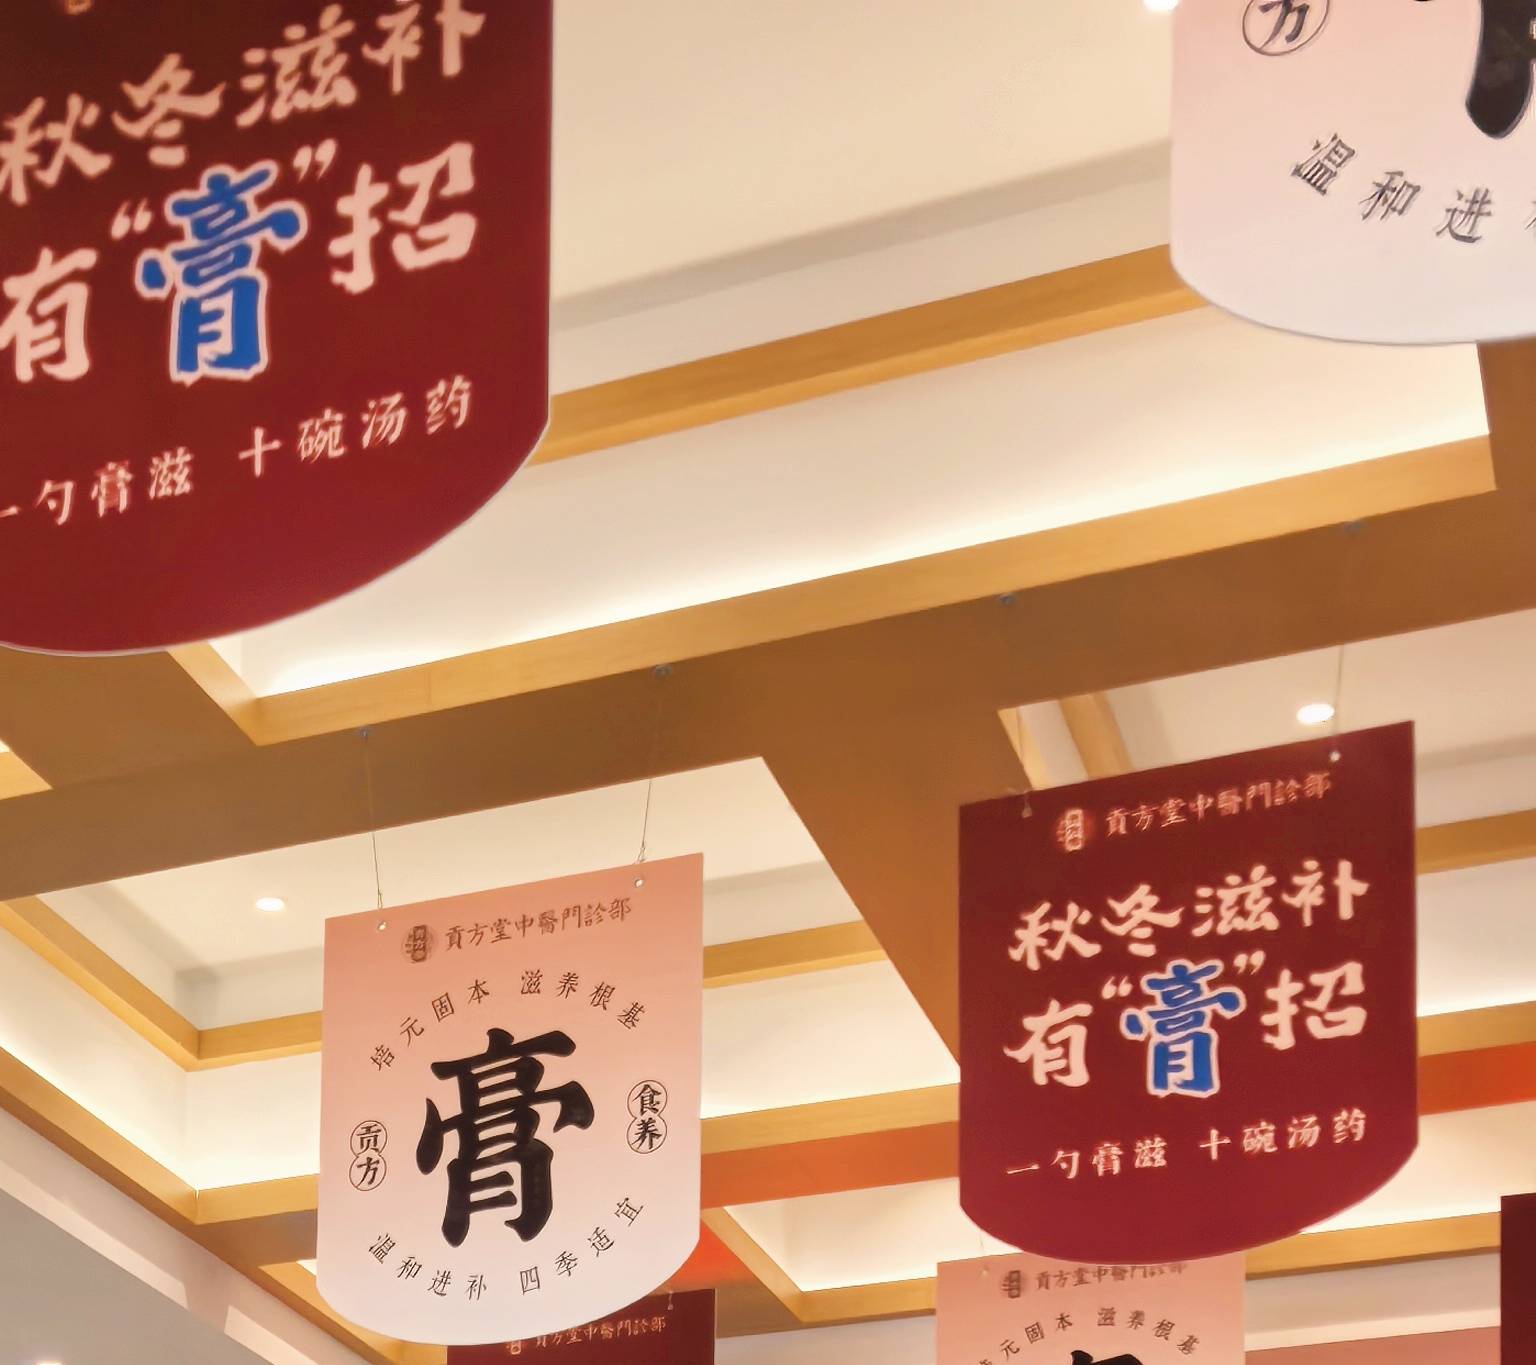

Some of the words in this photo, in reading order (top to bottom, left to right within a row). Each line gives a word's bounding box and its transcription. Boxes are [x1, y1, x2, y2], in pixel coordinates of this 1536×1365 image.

[239, 375, 473, 476] 十碗汤药
[1008, 859, 1369, 971] 秋冬滋补
[371, 979, 490, 1072] 培元固本
[520, 969, 647, 1030] 滋养根基
[1003, 951, 1368, 1099] 有“膏”招
[356, 1123, 384, 1187] 贡方
[417, 1028, 595, 1247] 膏
[631, 1083, 663, 1150] 食养
[1006, 1134, 1169, 1179] 一勺膏滋
[1199, 1108, 1366, 1162] 十碗汤药
[368, 1232, 486, 1301] 温和进补
[520, 1196, 643, 1296] 四季适宜
[1097, 1307, 1200, 1356] 滋养根基
